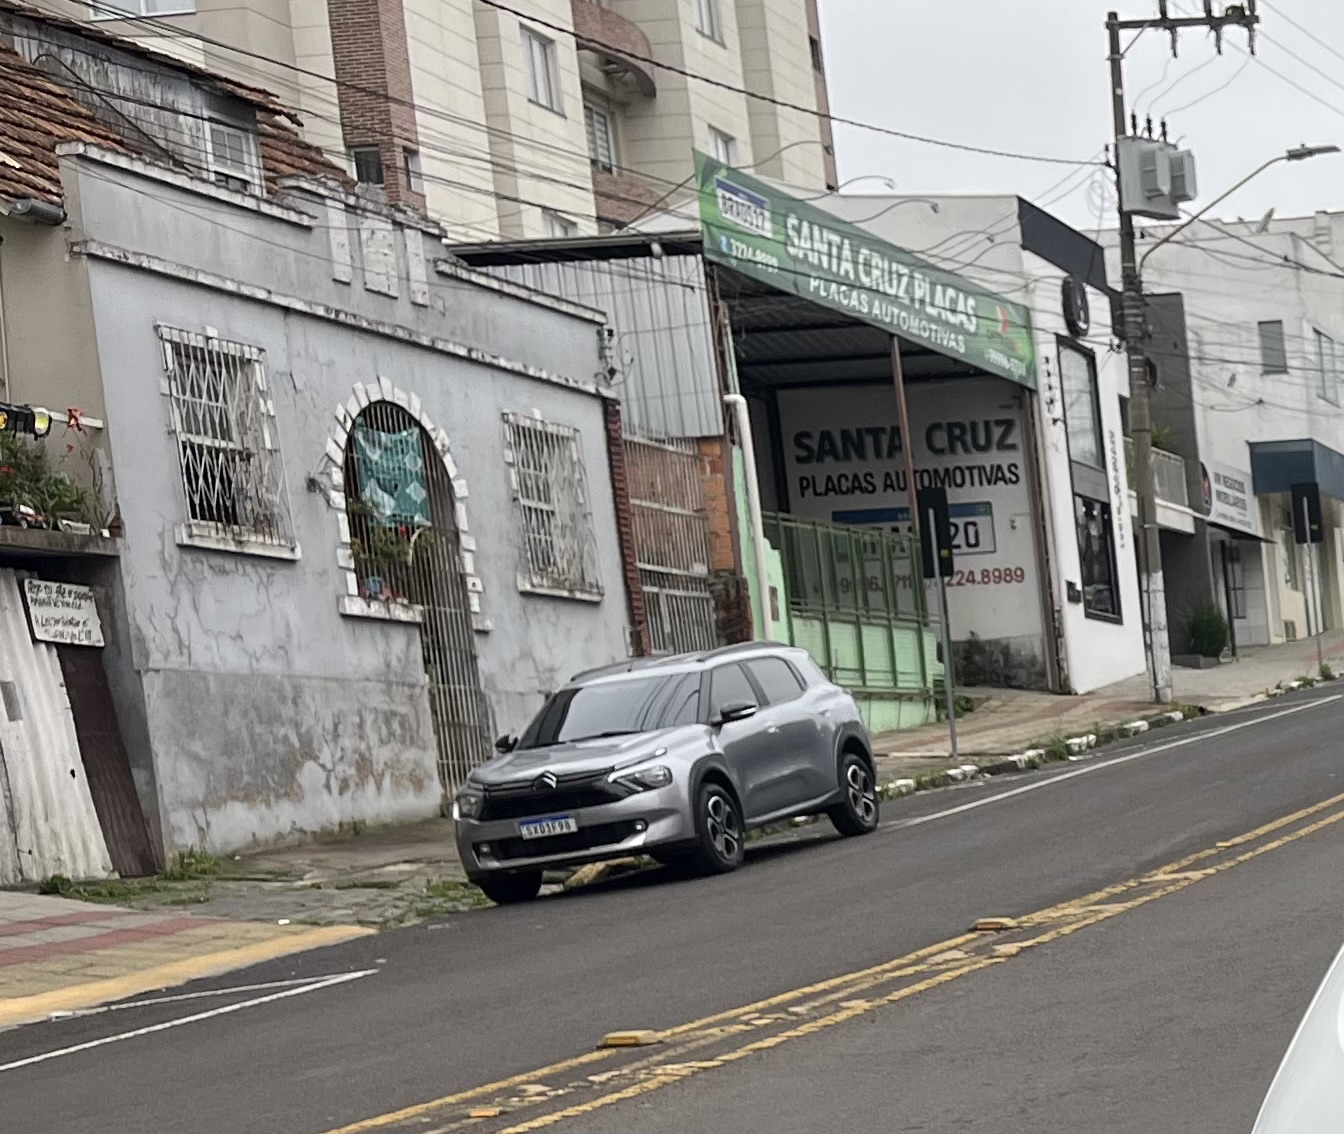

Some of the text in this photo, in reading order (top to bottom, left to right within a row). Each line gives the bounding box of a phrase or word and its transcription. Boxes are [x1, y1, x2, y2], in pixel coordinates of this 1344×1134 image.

[786, 213, 977, 333] SANTA CRUZ PLACAS
[809, 275, 868, 314] PLACAS
[872, 299, 966, 353] AUTOMOTIVAS
[793, 418, 1018, 464] SANTA CRUZ
[800, 463, 1020, 498] PLACAS AUOMOTIVAS
[945, 566, 1025, 588] 224.8989
